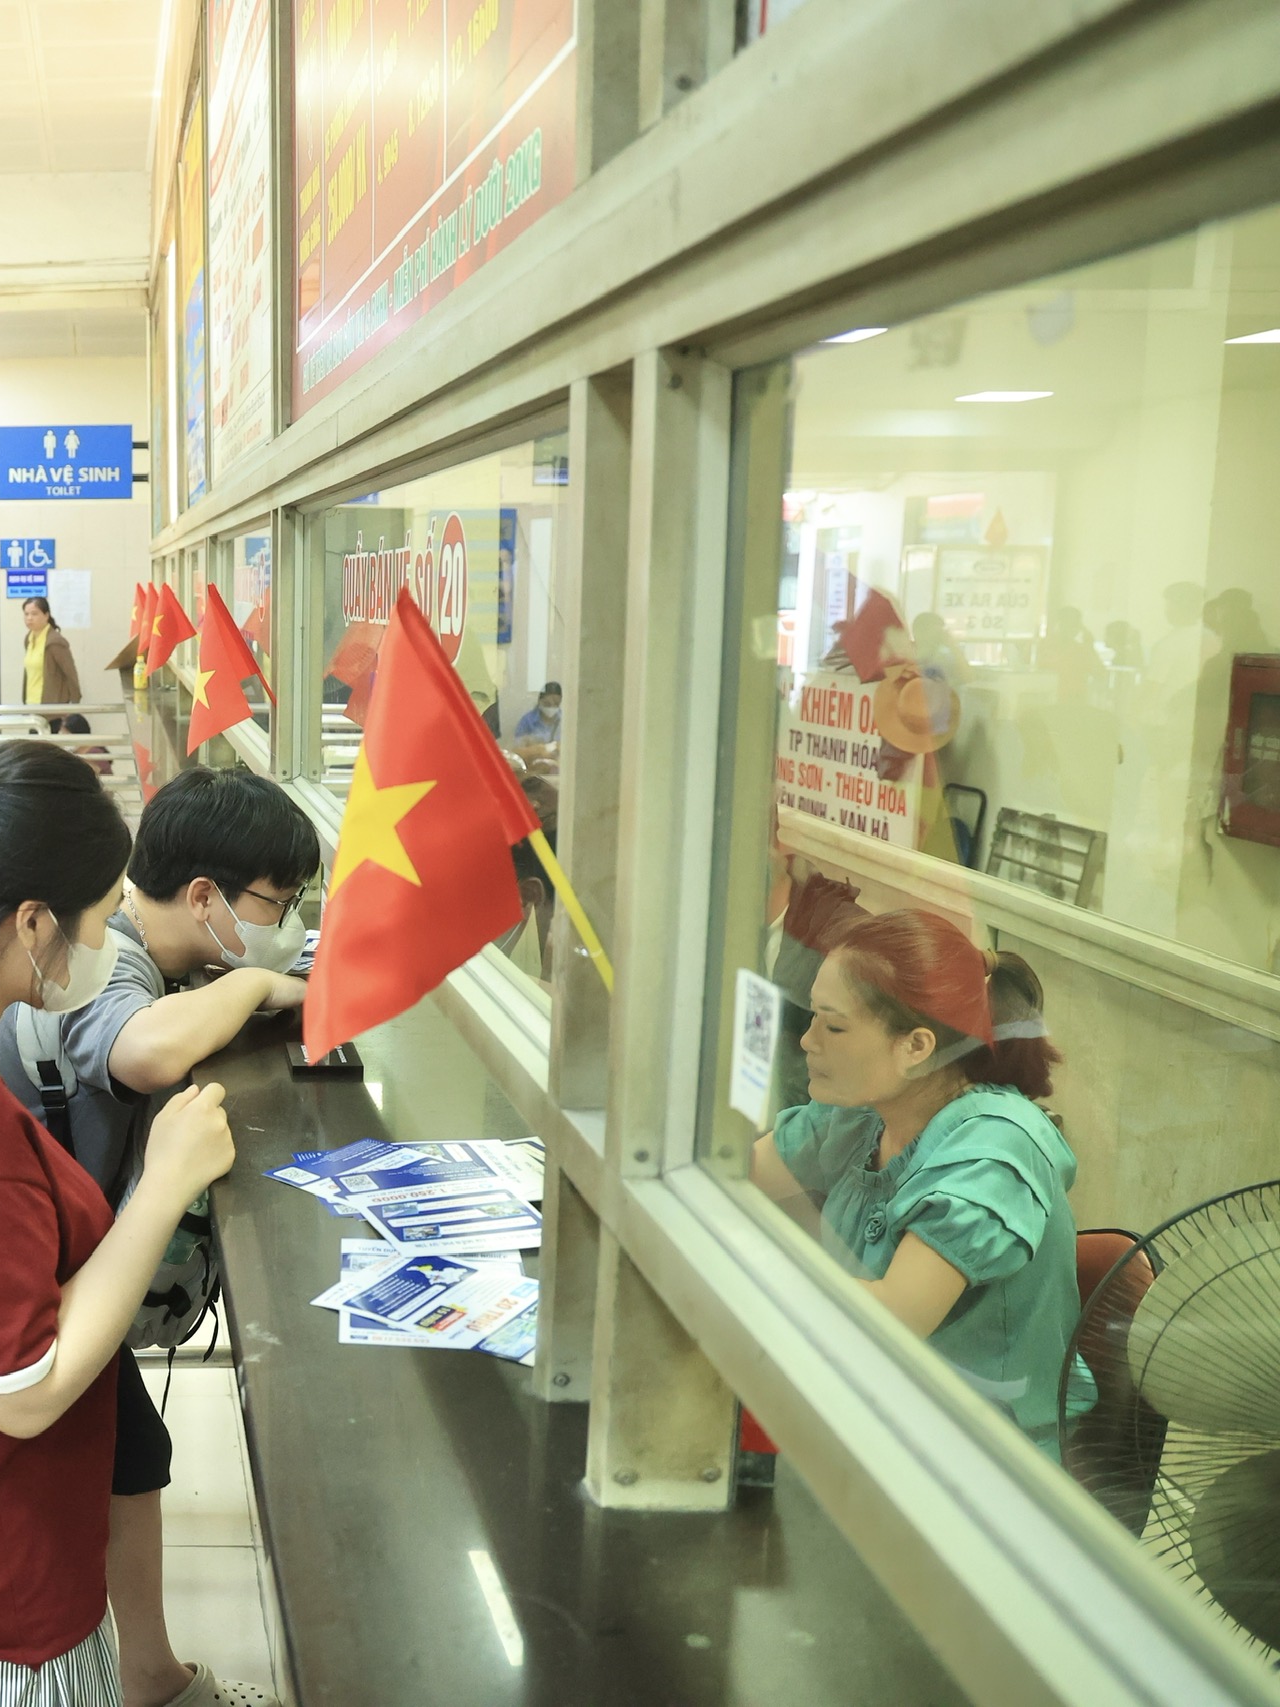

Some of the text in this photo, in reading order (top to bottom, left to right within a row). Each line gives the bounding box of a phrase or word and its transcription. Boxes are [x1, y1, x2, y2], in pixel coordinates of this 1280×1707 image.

[414, 226, 430, 298] PHÍ
[430, 214, 458, 283] HÀNH
[458, 184, 473, 260] LÝ
[474, 157, 504, 246] DƯỚI
[504, 126, 543, 219] 20KG
[8, 464, 120, 485] NHÀ VỆ SINH
[46, 486, 81, 496] TOILET
[342, 530, 369, 627] QUẦY
[369, 536, 393, 625] BÁN
[415, 516, 436, 627] SỐ
[440, 541, 464, 637] 20
[800, 682, 855, 730] KHIÊM
[789, 729, 880, 771] TP THANH HÓA
[798, 762, 824, 792] SƠN
[835, 771, 873, 809] THIỆU
